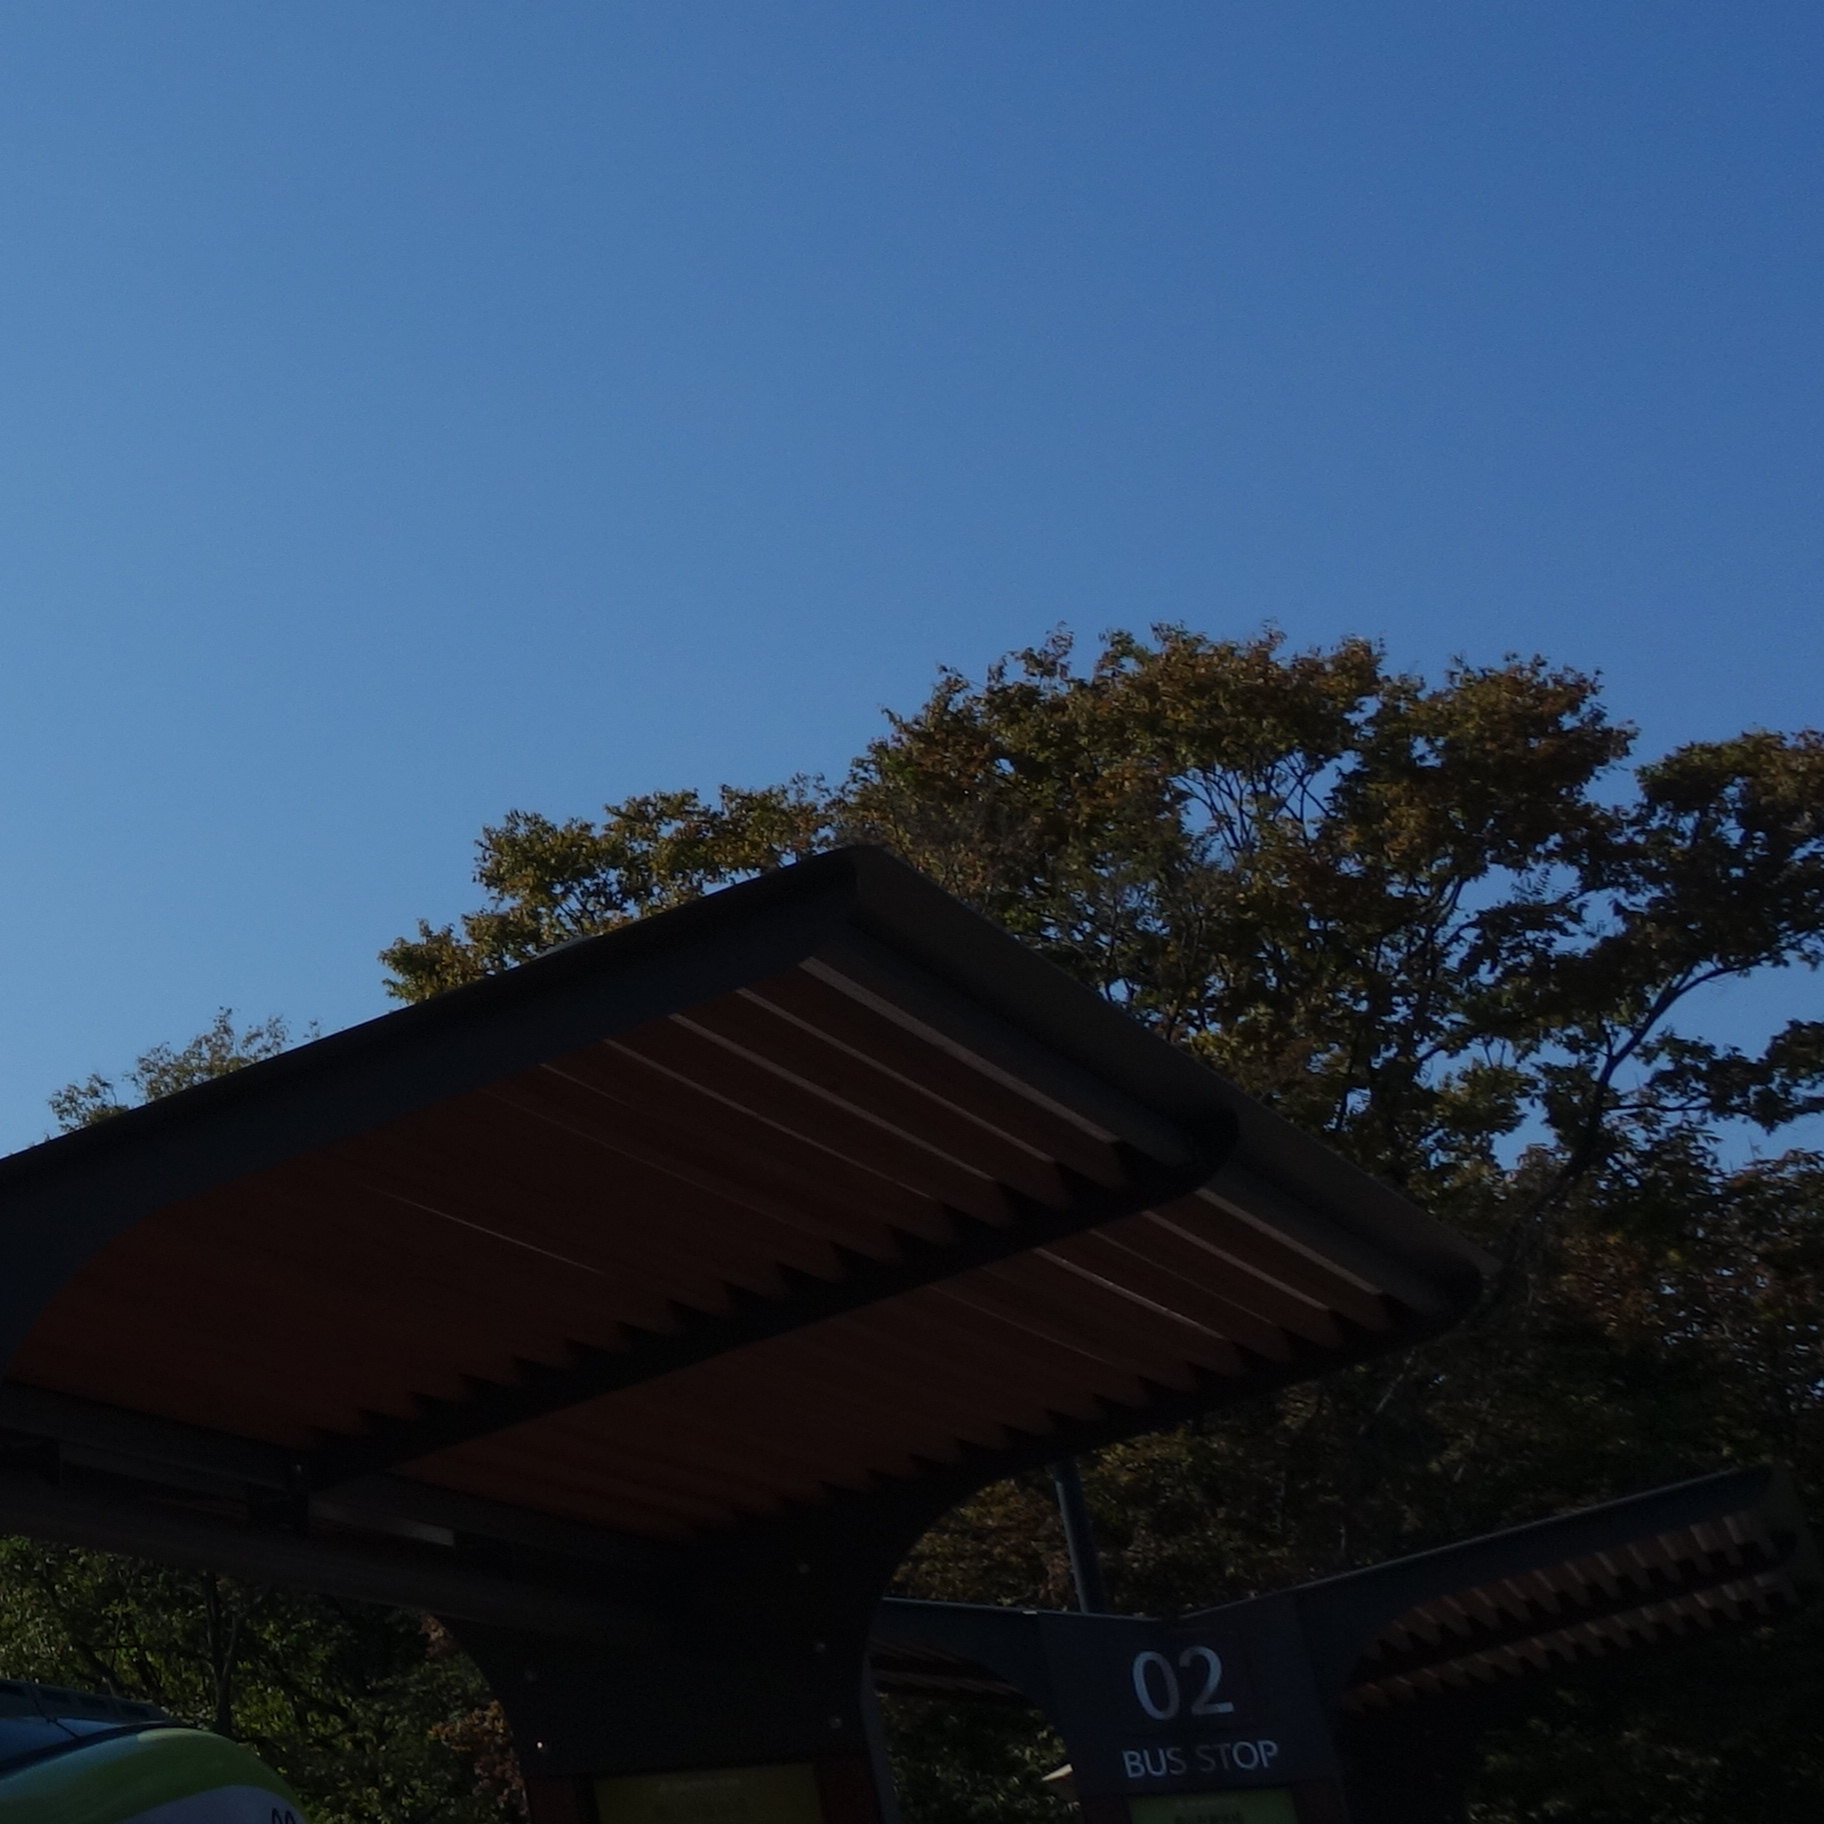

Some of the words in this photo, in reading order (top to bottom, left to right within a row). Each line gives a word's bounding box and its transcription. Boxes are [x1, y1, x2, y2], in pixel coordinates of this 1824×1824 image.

[1132, 1645, 1234, 1720] 02
[1121, 1747, 1188, 1778] BUS
[1195, 1739, 1279, 1772] STOP
